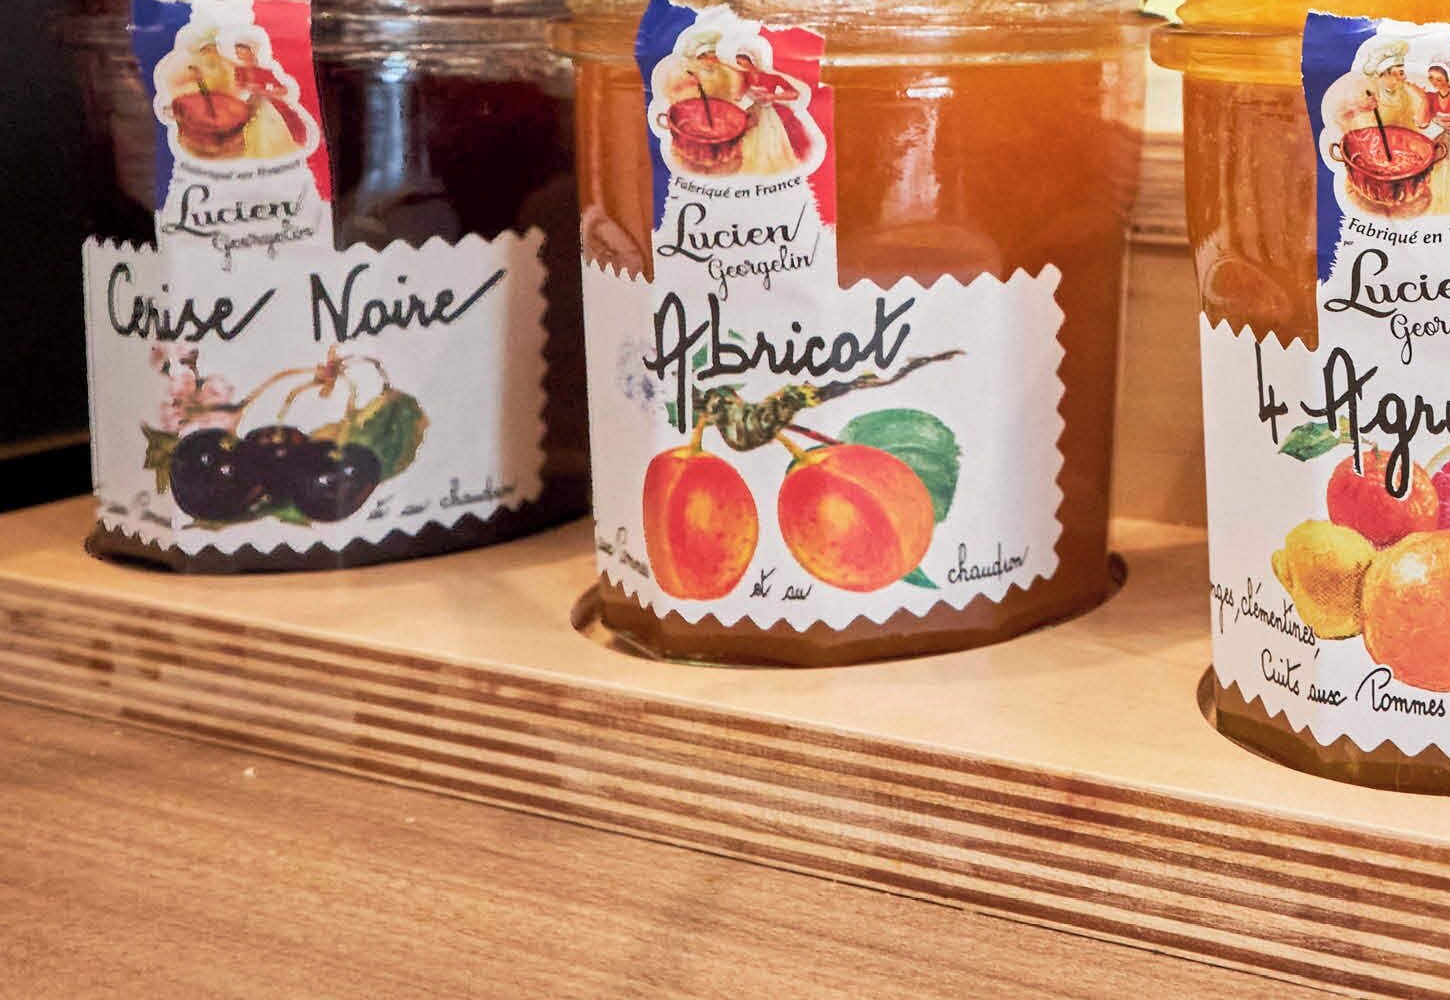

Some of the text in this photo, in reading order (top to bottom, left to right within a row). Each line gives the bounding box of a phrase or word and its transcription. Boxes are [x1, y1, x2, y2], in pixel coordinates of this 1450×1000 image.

[161, 184, 306, 237] Lucien
[675, 176, 802, 199] Fabriqué en France
[656, 202, 807, 263] Lucien
[1348, 217, 1418, 246] Fabriqué
[1423, 231, 1443, 244] en
[107, 261, 507, 343] Cerise Noire
[708, 233, 820, 302] Georgelin
[642, 291, 916, 434] Abricot
[1255, 342, 1288, 445] 4
[750, 567, 813, 602] et au
[1240, 577, 1320, 660] clémentines,
[1261, 648, 1302, 696] Cuits
[1306, 683, 1347, 706] aux
[1355, 667, 1446, 718] Pommes
